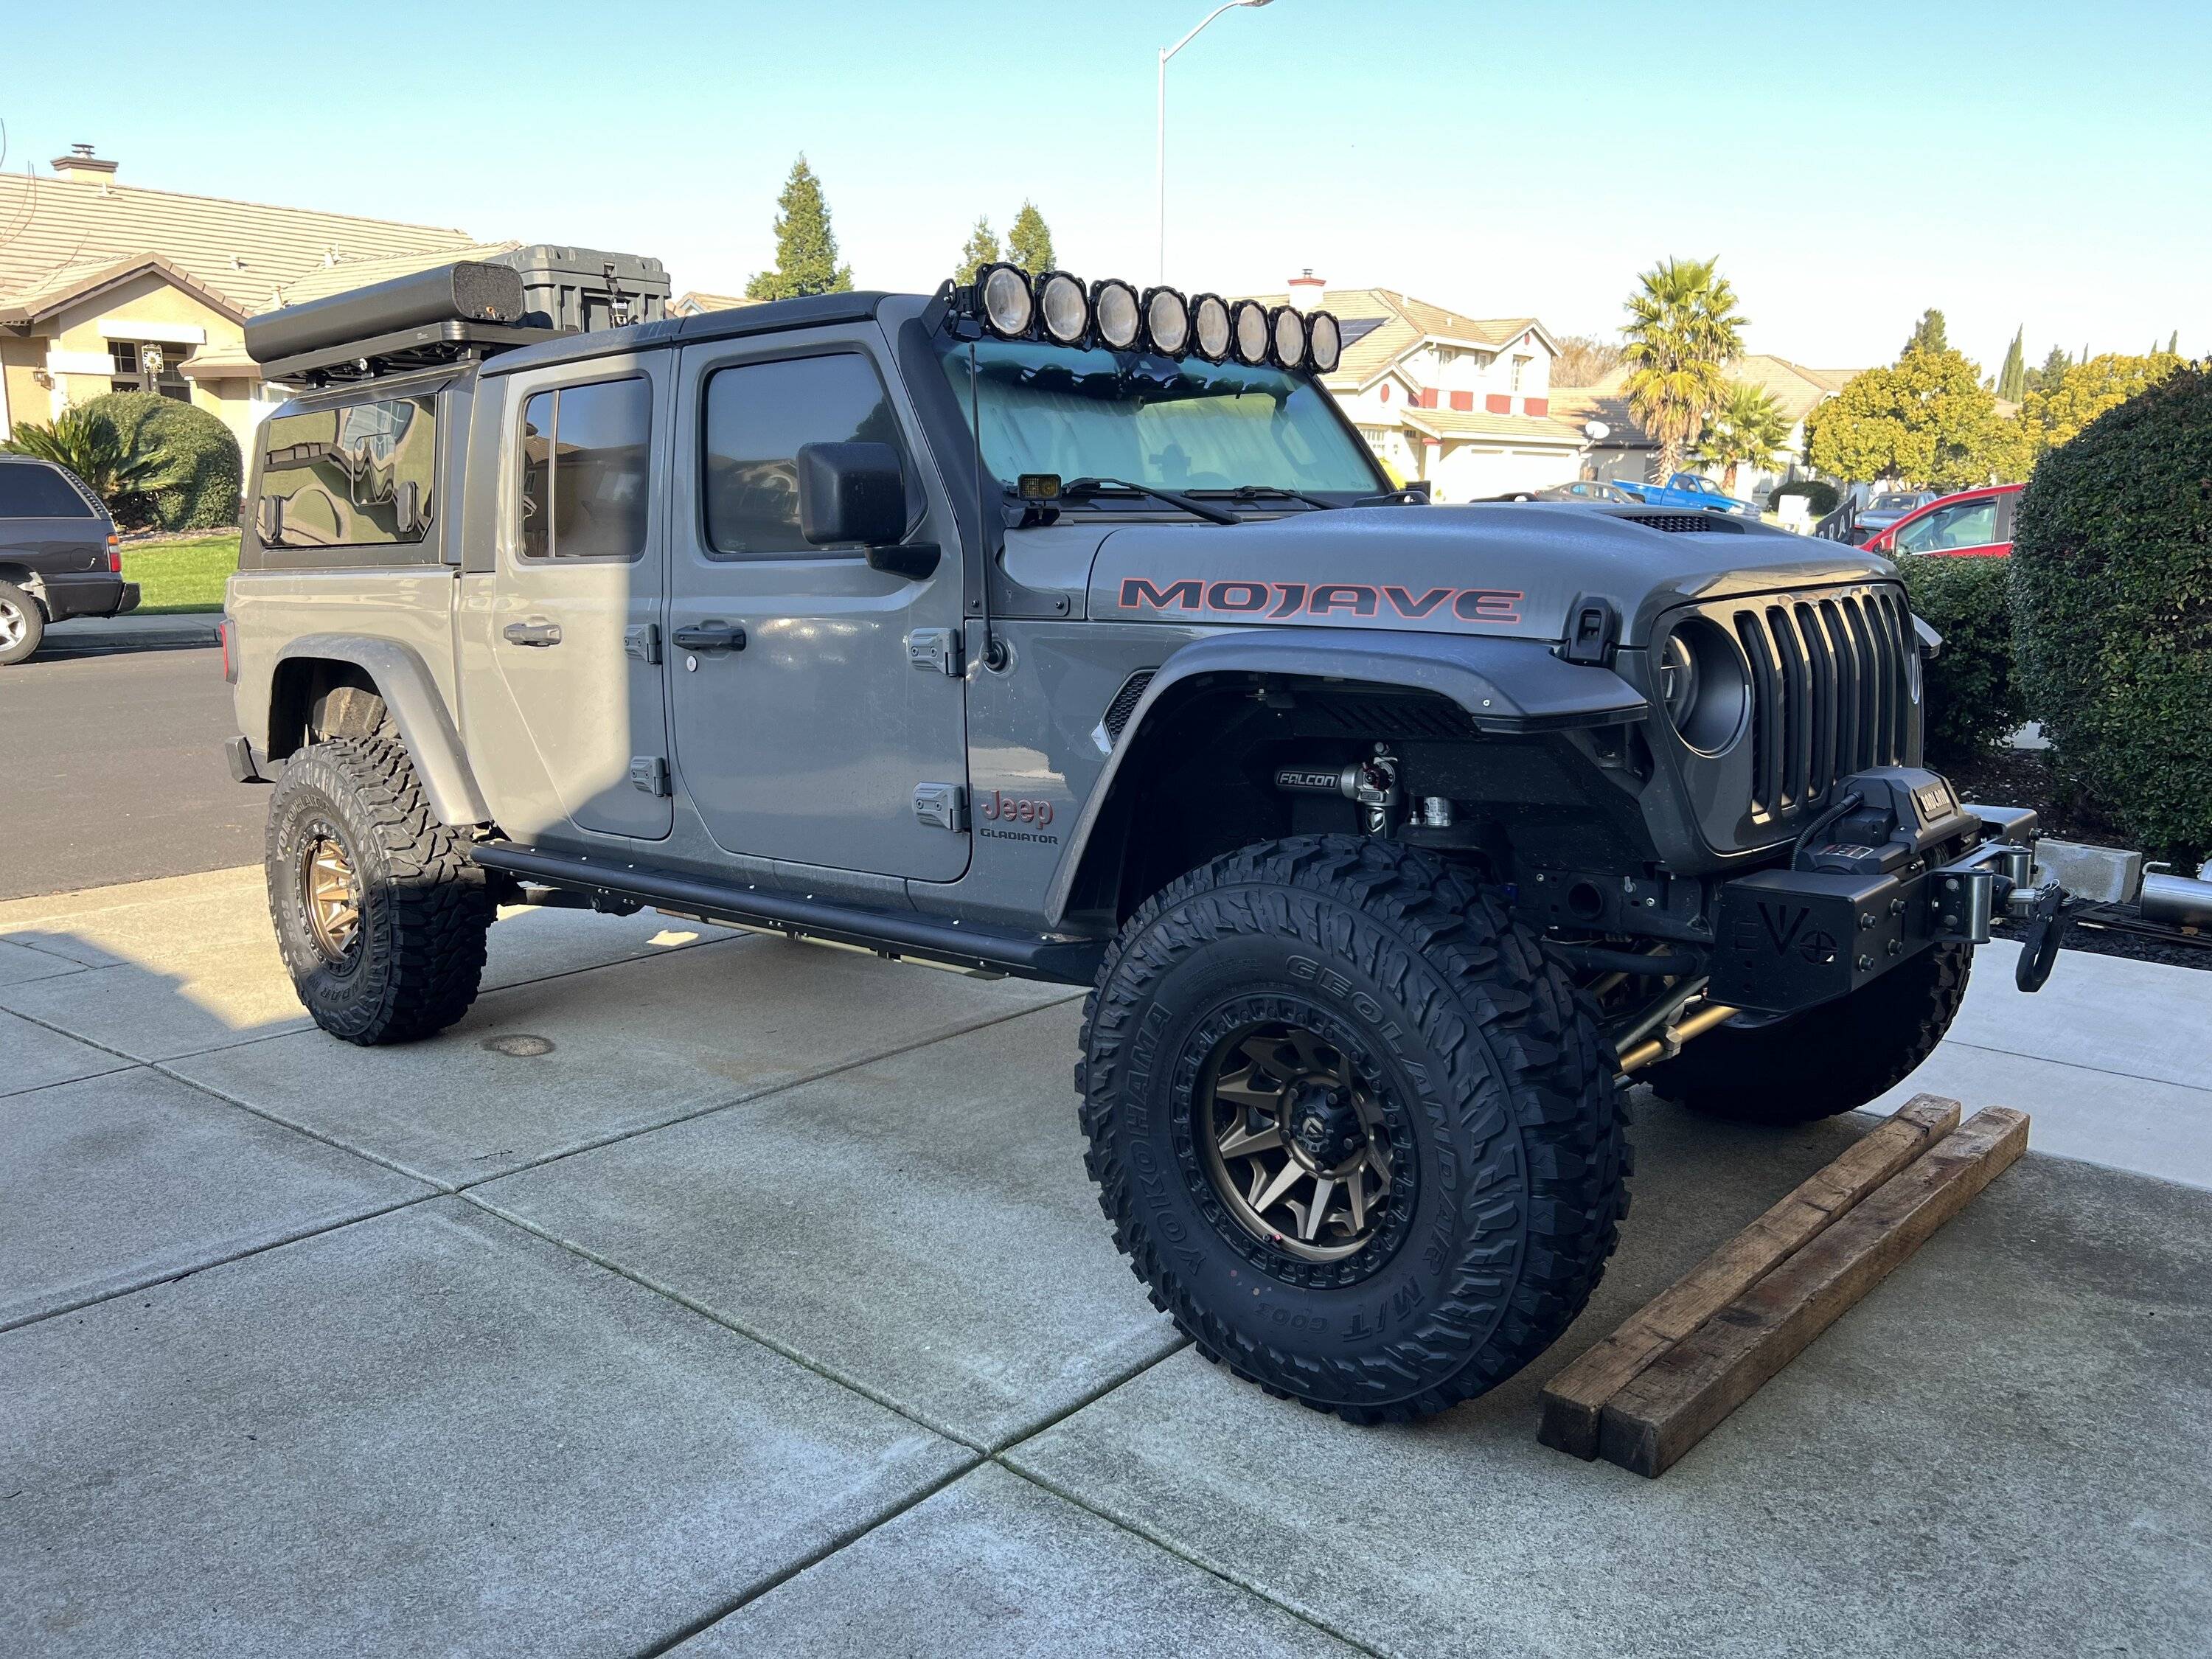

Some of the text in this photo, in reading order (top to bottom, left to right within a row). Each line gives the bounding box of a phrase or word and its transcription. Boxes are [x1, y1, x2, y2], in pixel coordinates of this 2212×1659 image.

[1118, 577, 1524, 625] MOJAVE
[1279, 772, 1335, 787] FALCON
[980, 790, 1054, 830] Jeep
[980, 828, 1060, 845] GLADIATOR
[1125, 1002, 1207, 1276] YOKOHAMA
[1285, 955, 1458, 1276] GEOLANDAR
[1340, 1276, 1425, 1342] M/T
